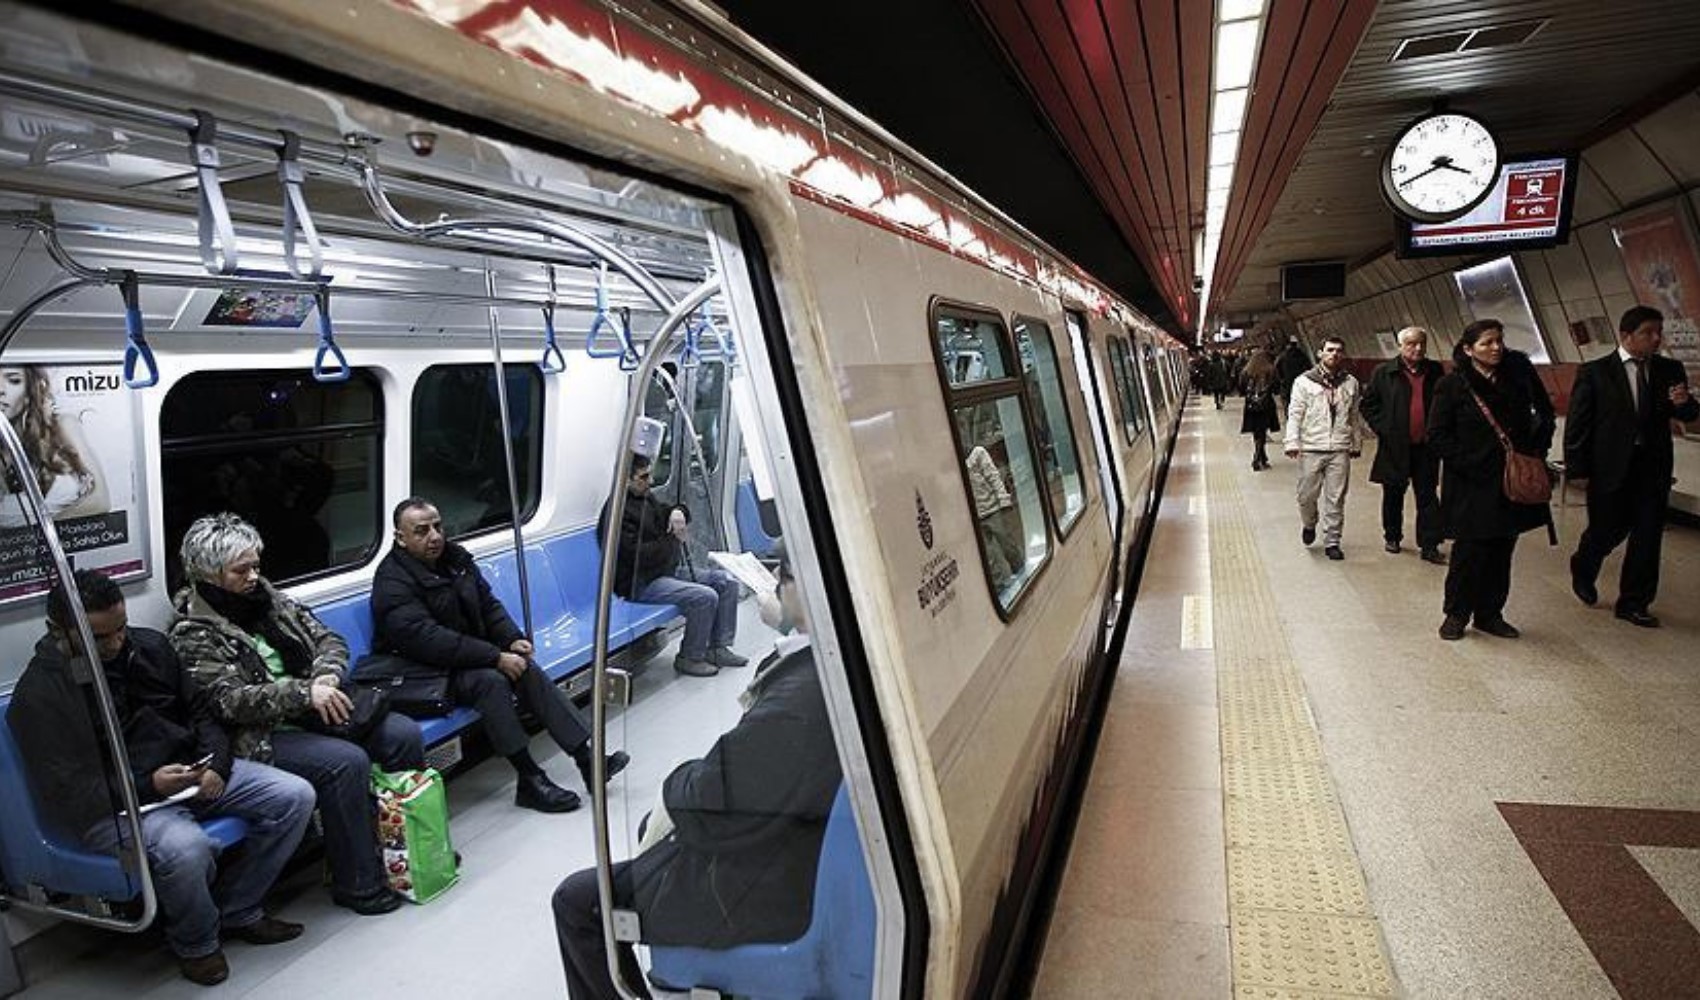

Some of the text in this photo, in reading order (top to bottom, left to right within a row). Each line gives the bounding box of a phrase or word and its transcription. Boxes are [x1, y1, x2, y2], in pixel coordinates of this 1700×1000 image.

[1436, 122, 1449, 133] 12
[1405, 145, 1419, 156] 10
[1398, 164, 1407, 174] 9
[1516, 205, 1546, 216] 4 dk
[65, 370, 120, 391] mizu
